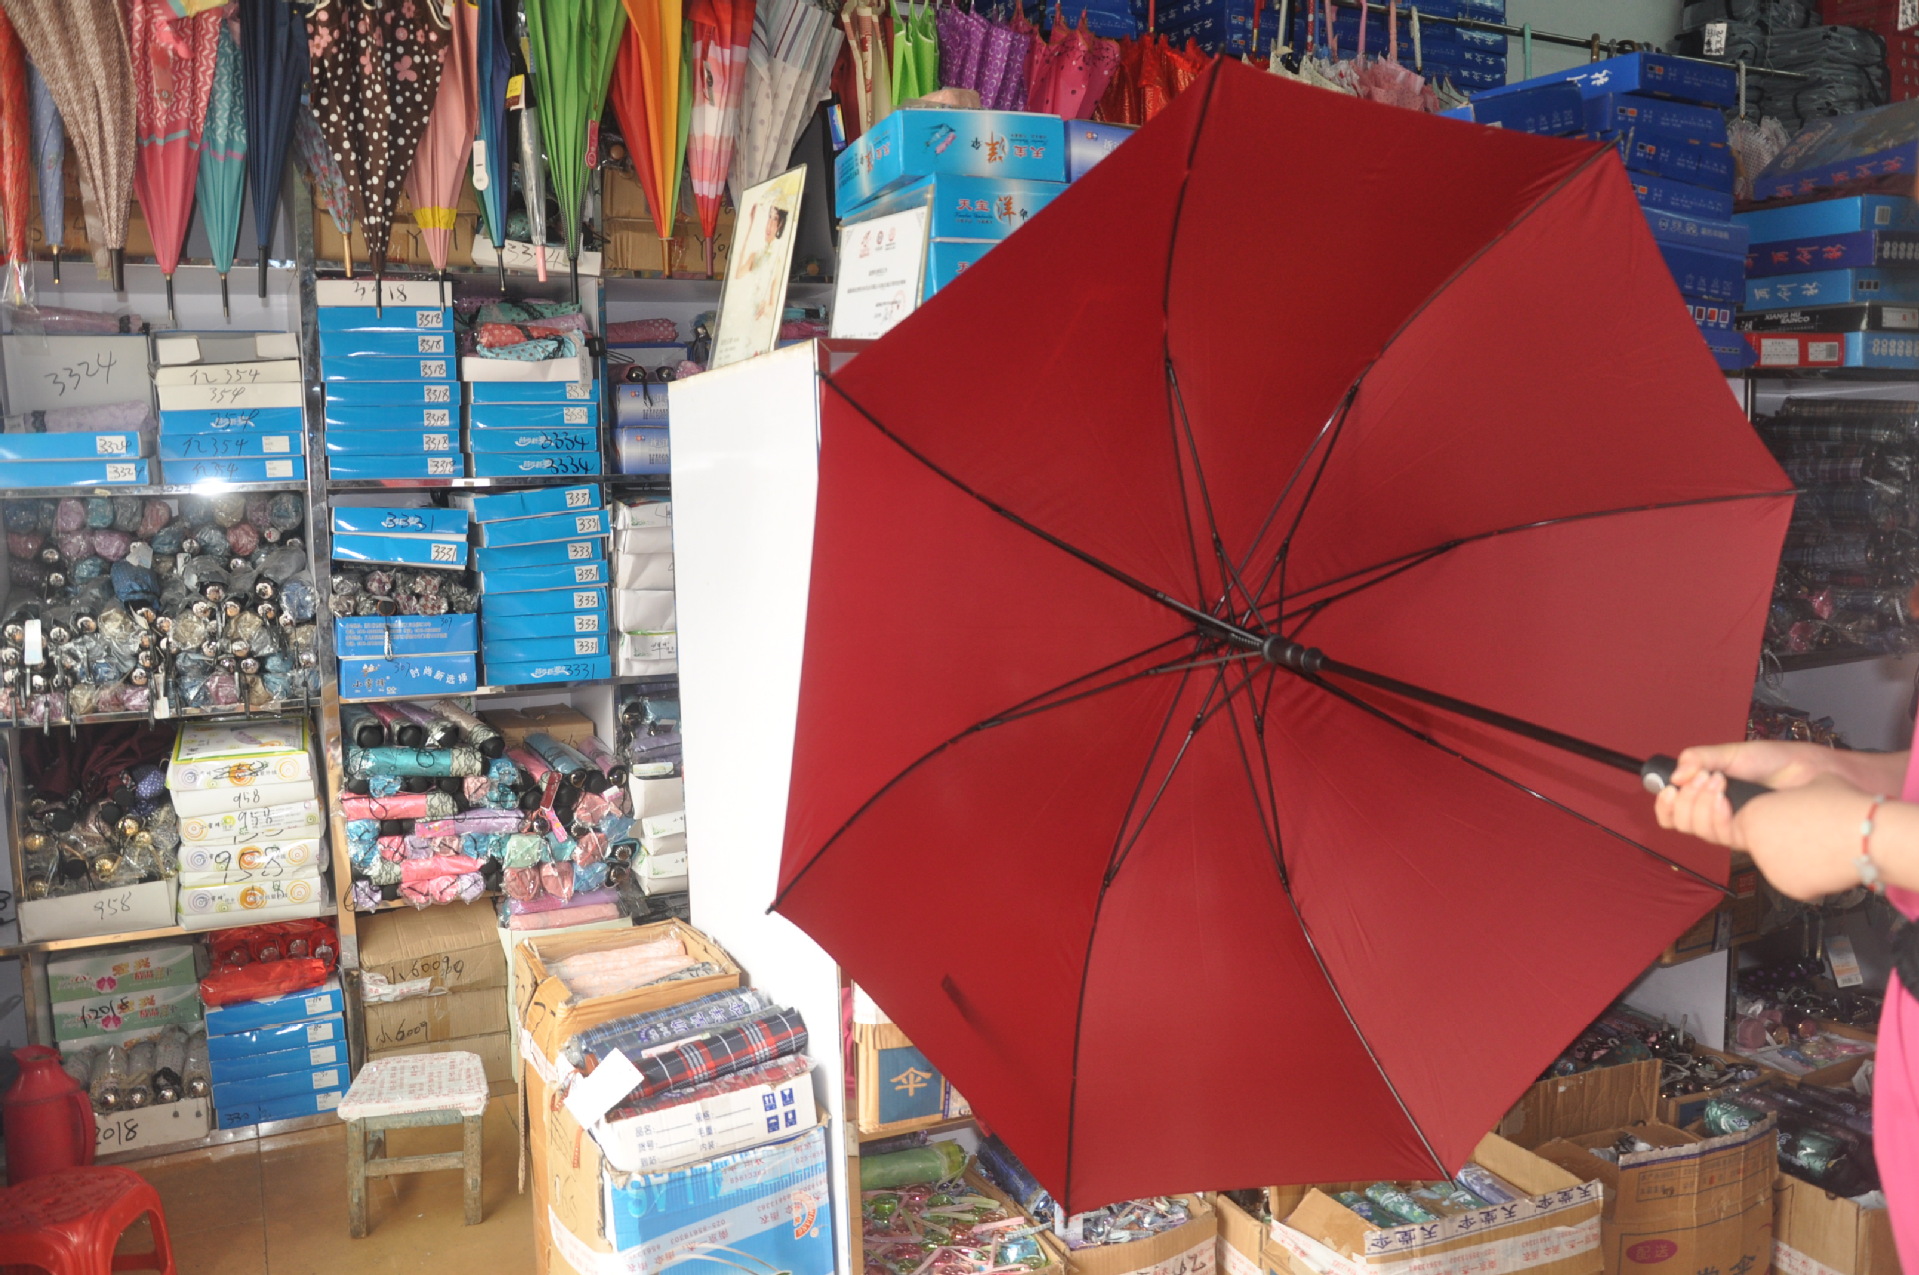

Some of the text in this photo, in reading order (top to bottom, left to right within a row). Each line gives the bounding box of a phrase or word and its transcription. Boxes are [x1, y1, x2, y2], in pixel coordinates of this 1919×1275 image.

[44, 350, 117, 397] 3324
[94, 891, 133, 920] 958
[889, 1066, 933, 1098] 伞
[1369, 1223, 1438, 1250] 天堂伞
